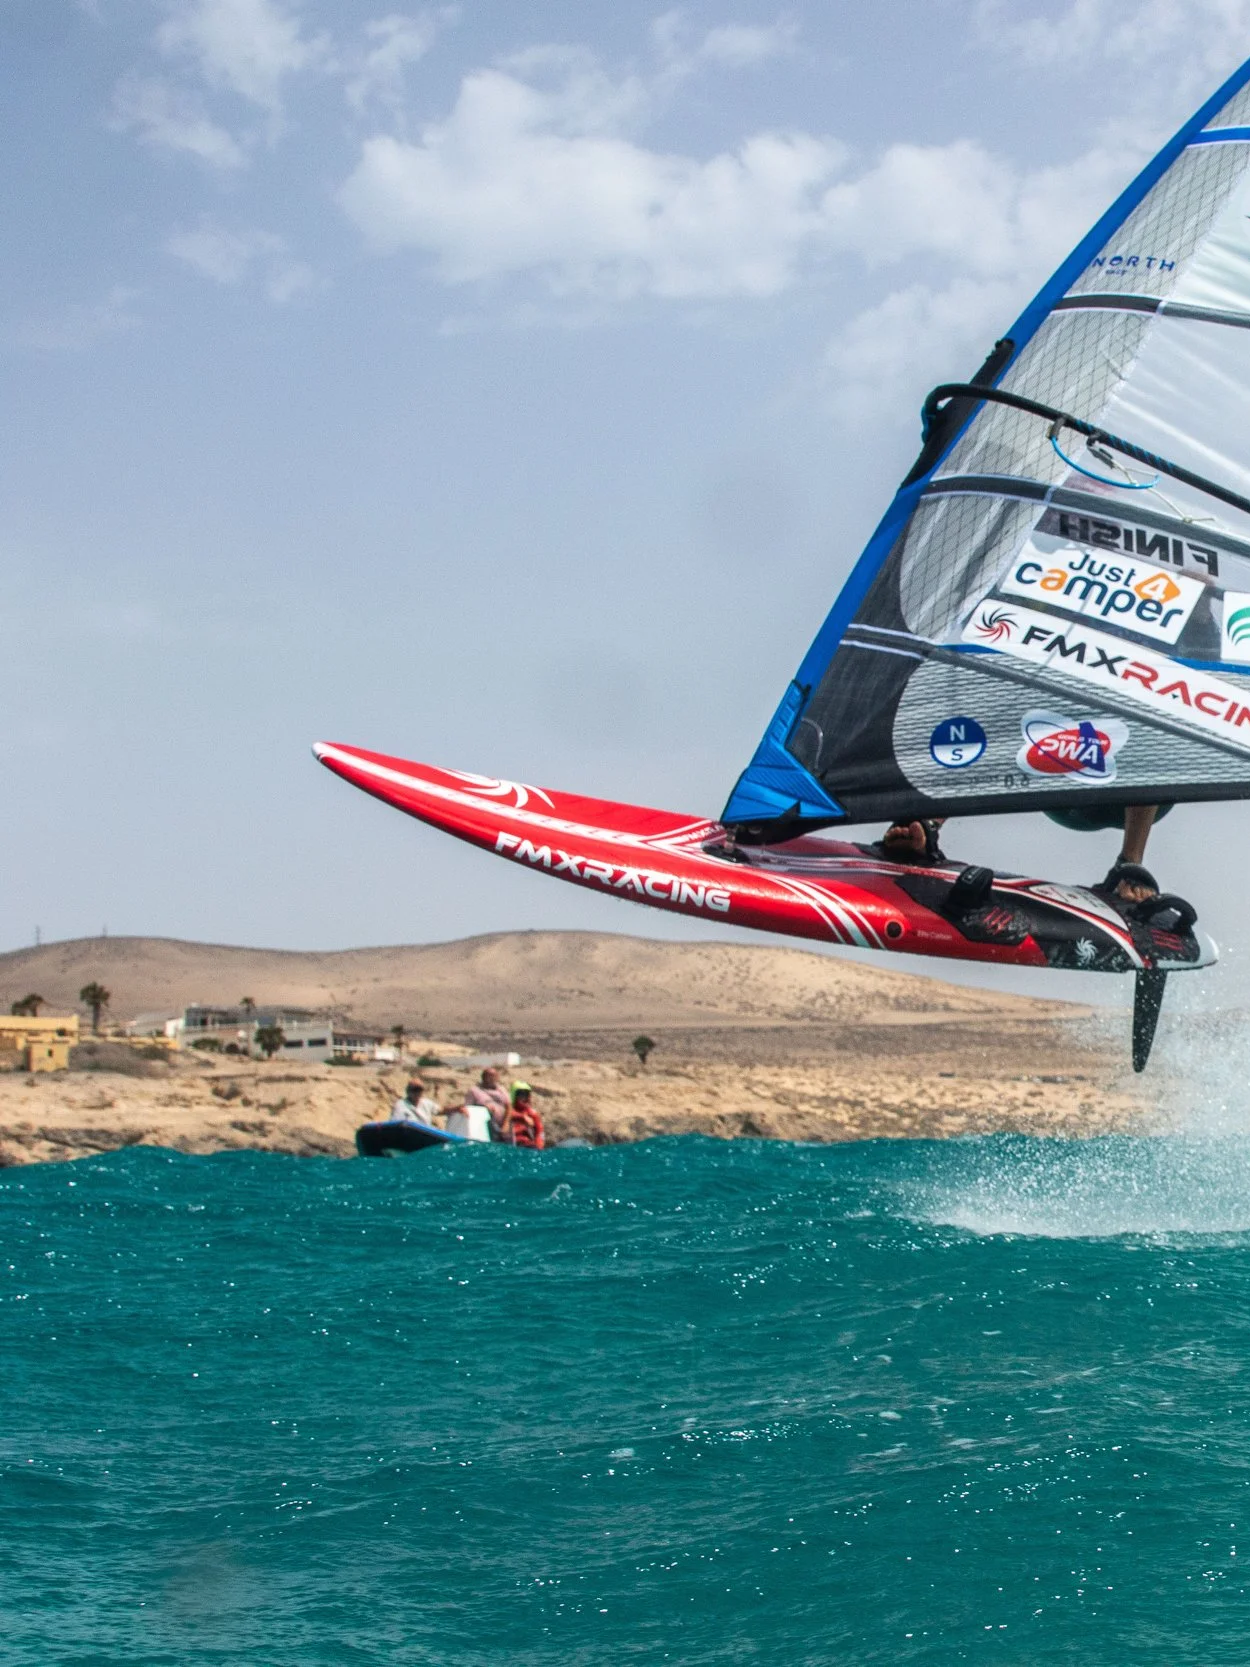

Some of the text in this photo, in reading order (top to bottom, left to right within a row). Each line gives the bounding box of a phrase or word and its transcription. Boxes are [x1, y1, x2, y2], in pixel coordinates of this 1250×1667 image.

[1092, 255, 1175, 271] NORTH
[1068, 553, 1166, 601] Just 4
[1015, 562, 1184, 628] camper
[949, 724, 966, 742] N
[951, 748, 963, 761] S
[1037, 738, 1099, 765] PWA
[495, 831, 731, 912] FMXRACING
